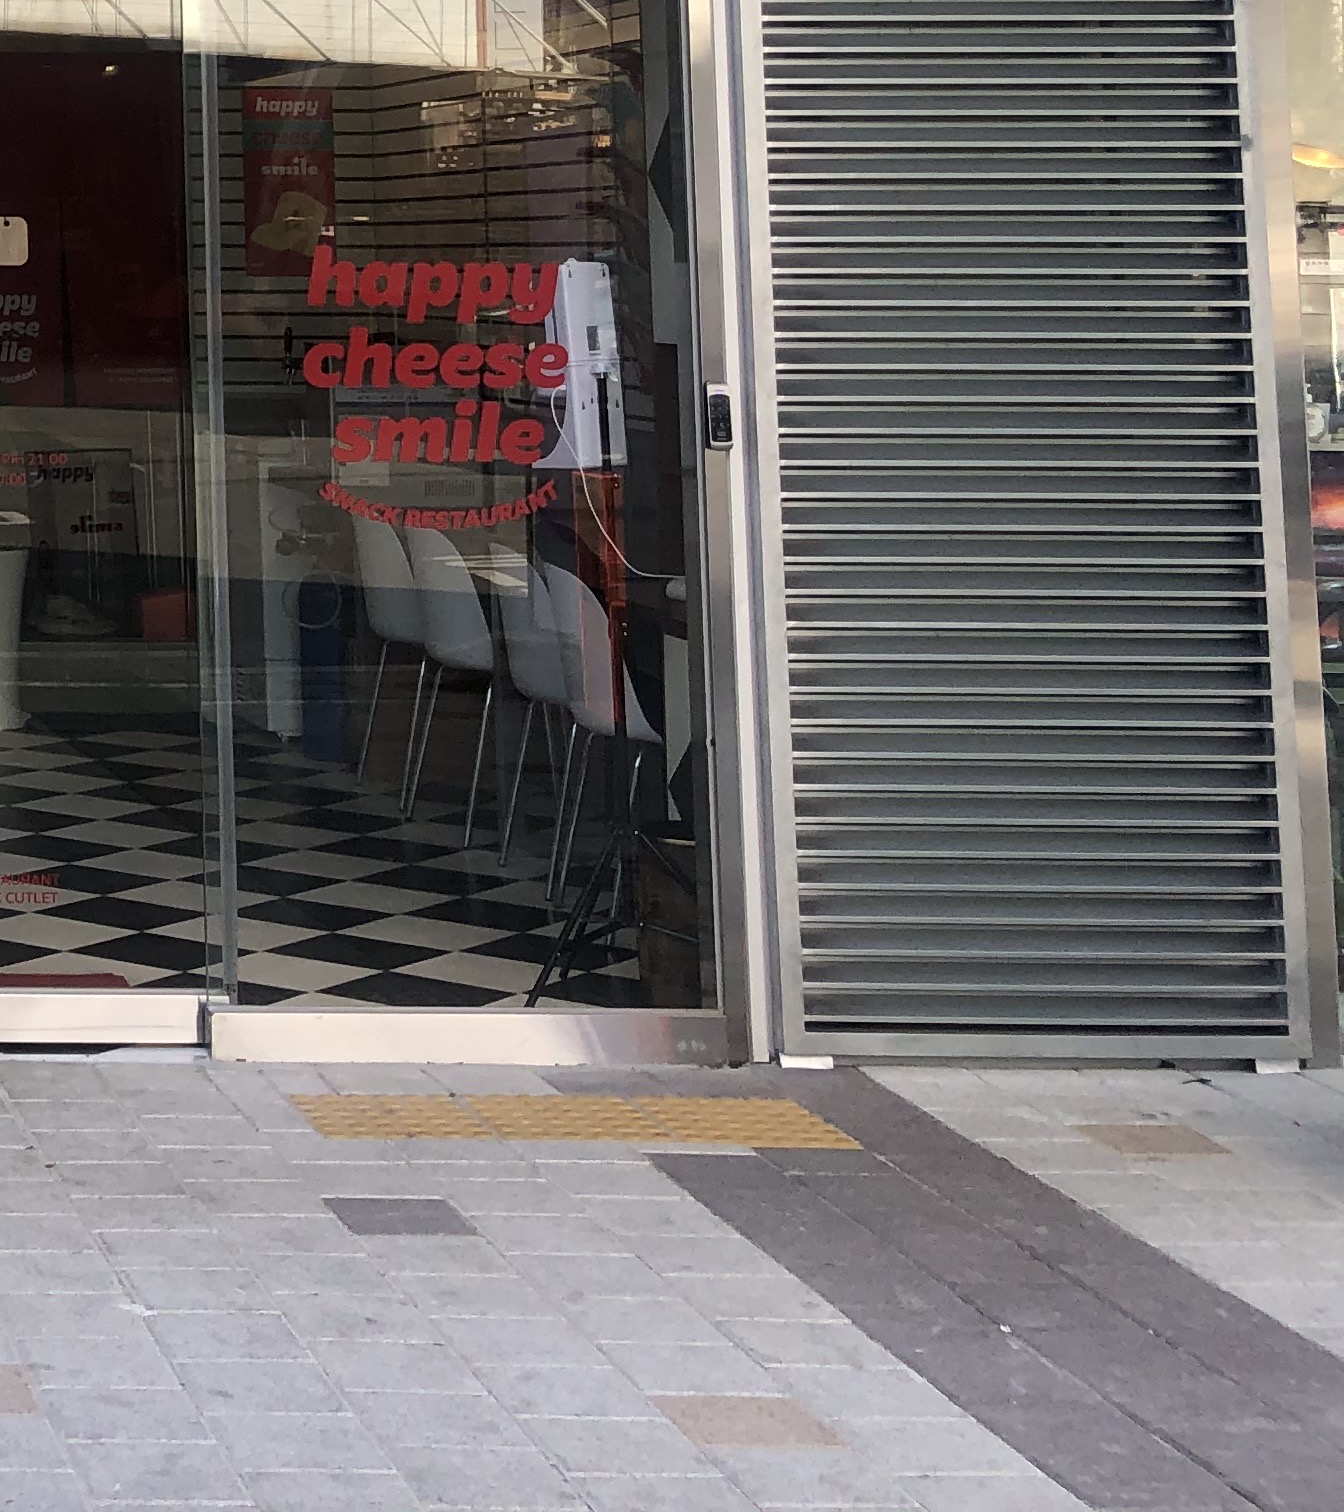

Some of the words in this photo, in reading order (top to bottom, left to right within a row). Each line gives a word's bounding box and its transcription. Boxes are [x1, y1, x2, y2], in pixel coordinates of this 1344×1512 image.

[254, 96, 319, 118] happy
[261, 155, 319, 176] smile
[306, 244, 564, 325] happy
[302, 326, 570, 389] cheese
[330, 400, 546, 465] smile
[318, 481, 399, 524] SNACK
[403, 479, 558, 530] RESTAURANT
[5, 891, 59, 904] CUTLET
